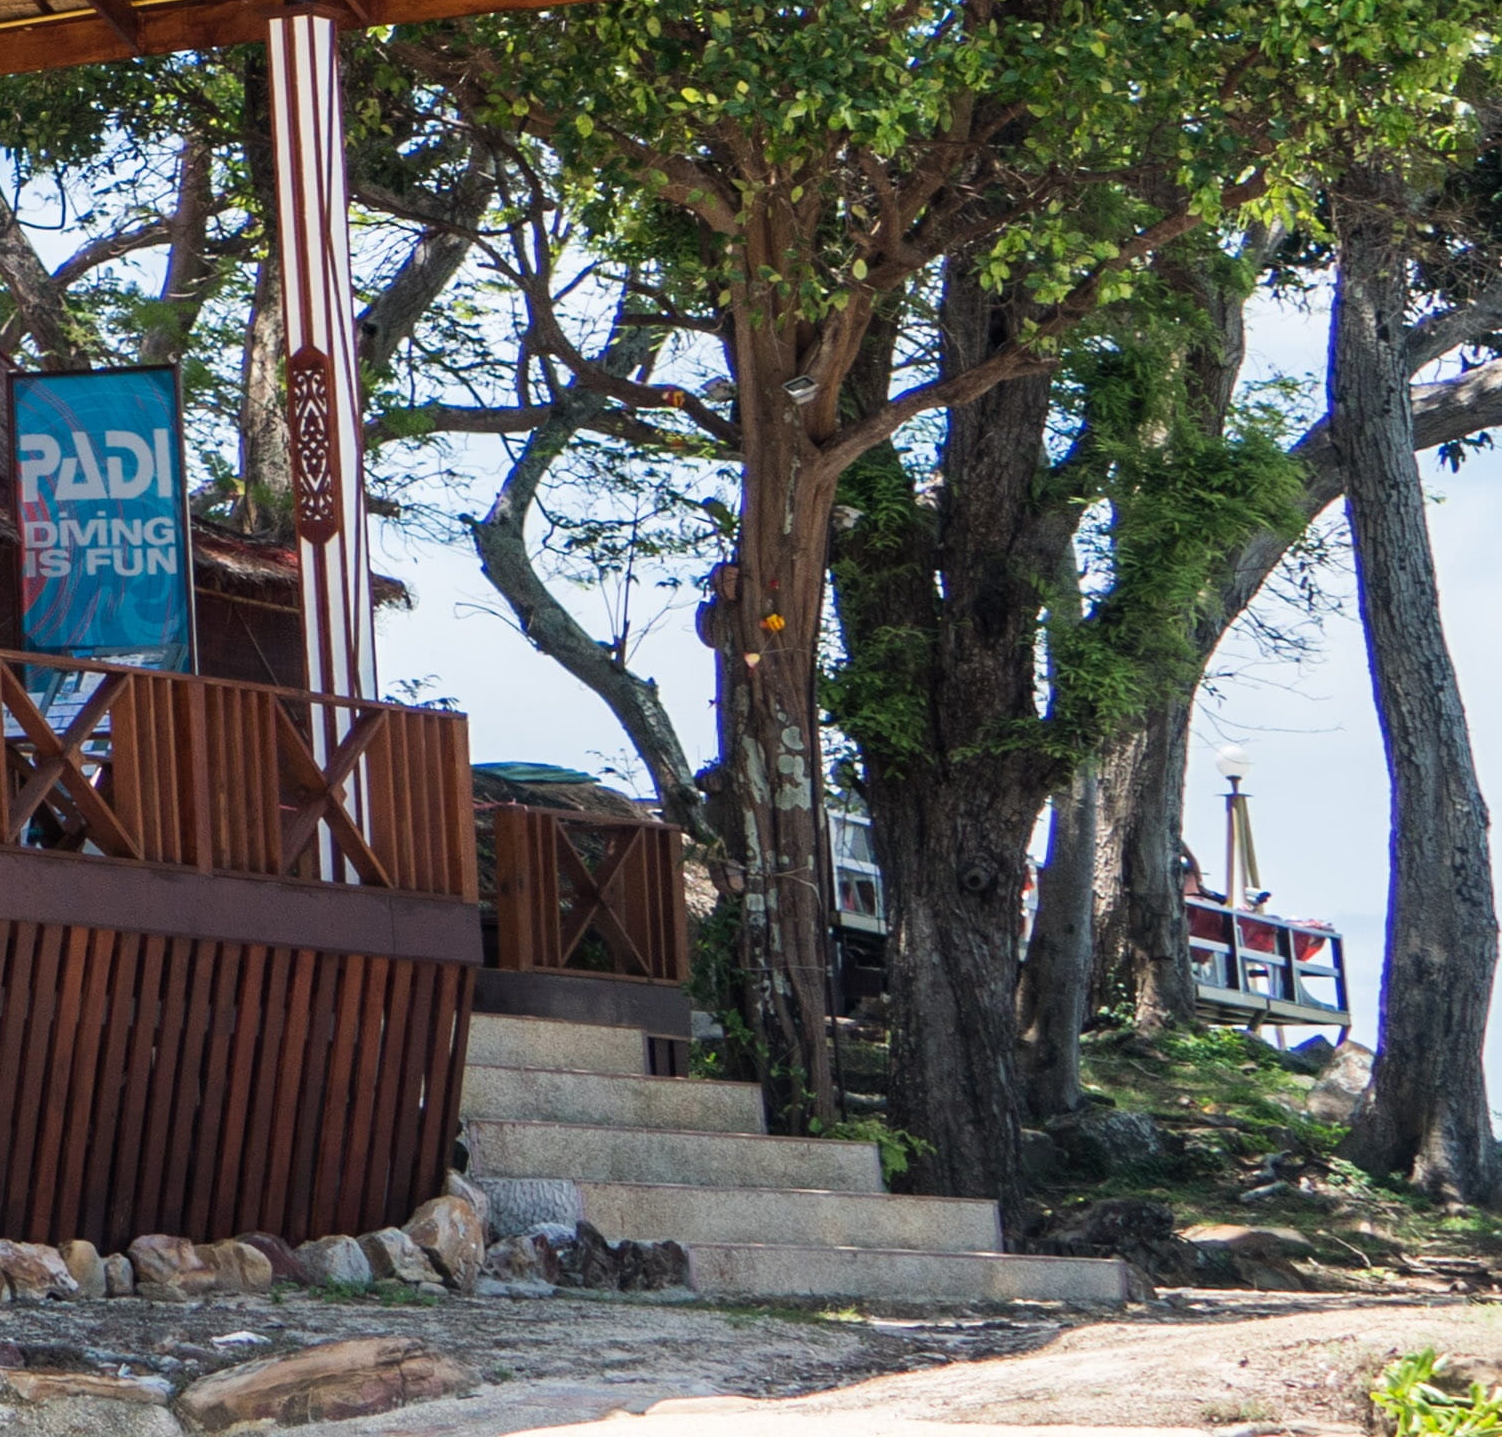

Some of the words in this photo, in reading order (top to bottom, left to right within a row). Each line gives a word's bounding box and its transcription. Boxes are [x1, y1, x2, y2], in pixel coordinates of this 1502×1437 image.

[19, 428, 173, 503] PADI
[26, 549, 71, 578] IS
[86, 547, 177, 575] FUN
